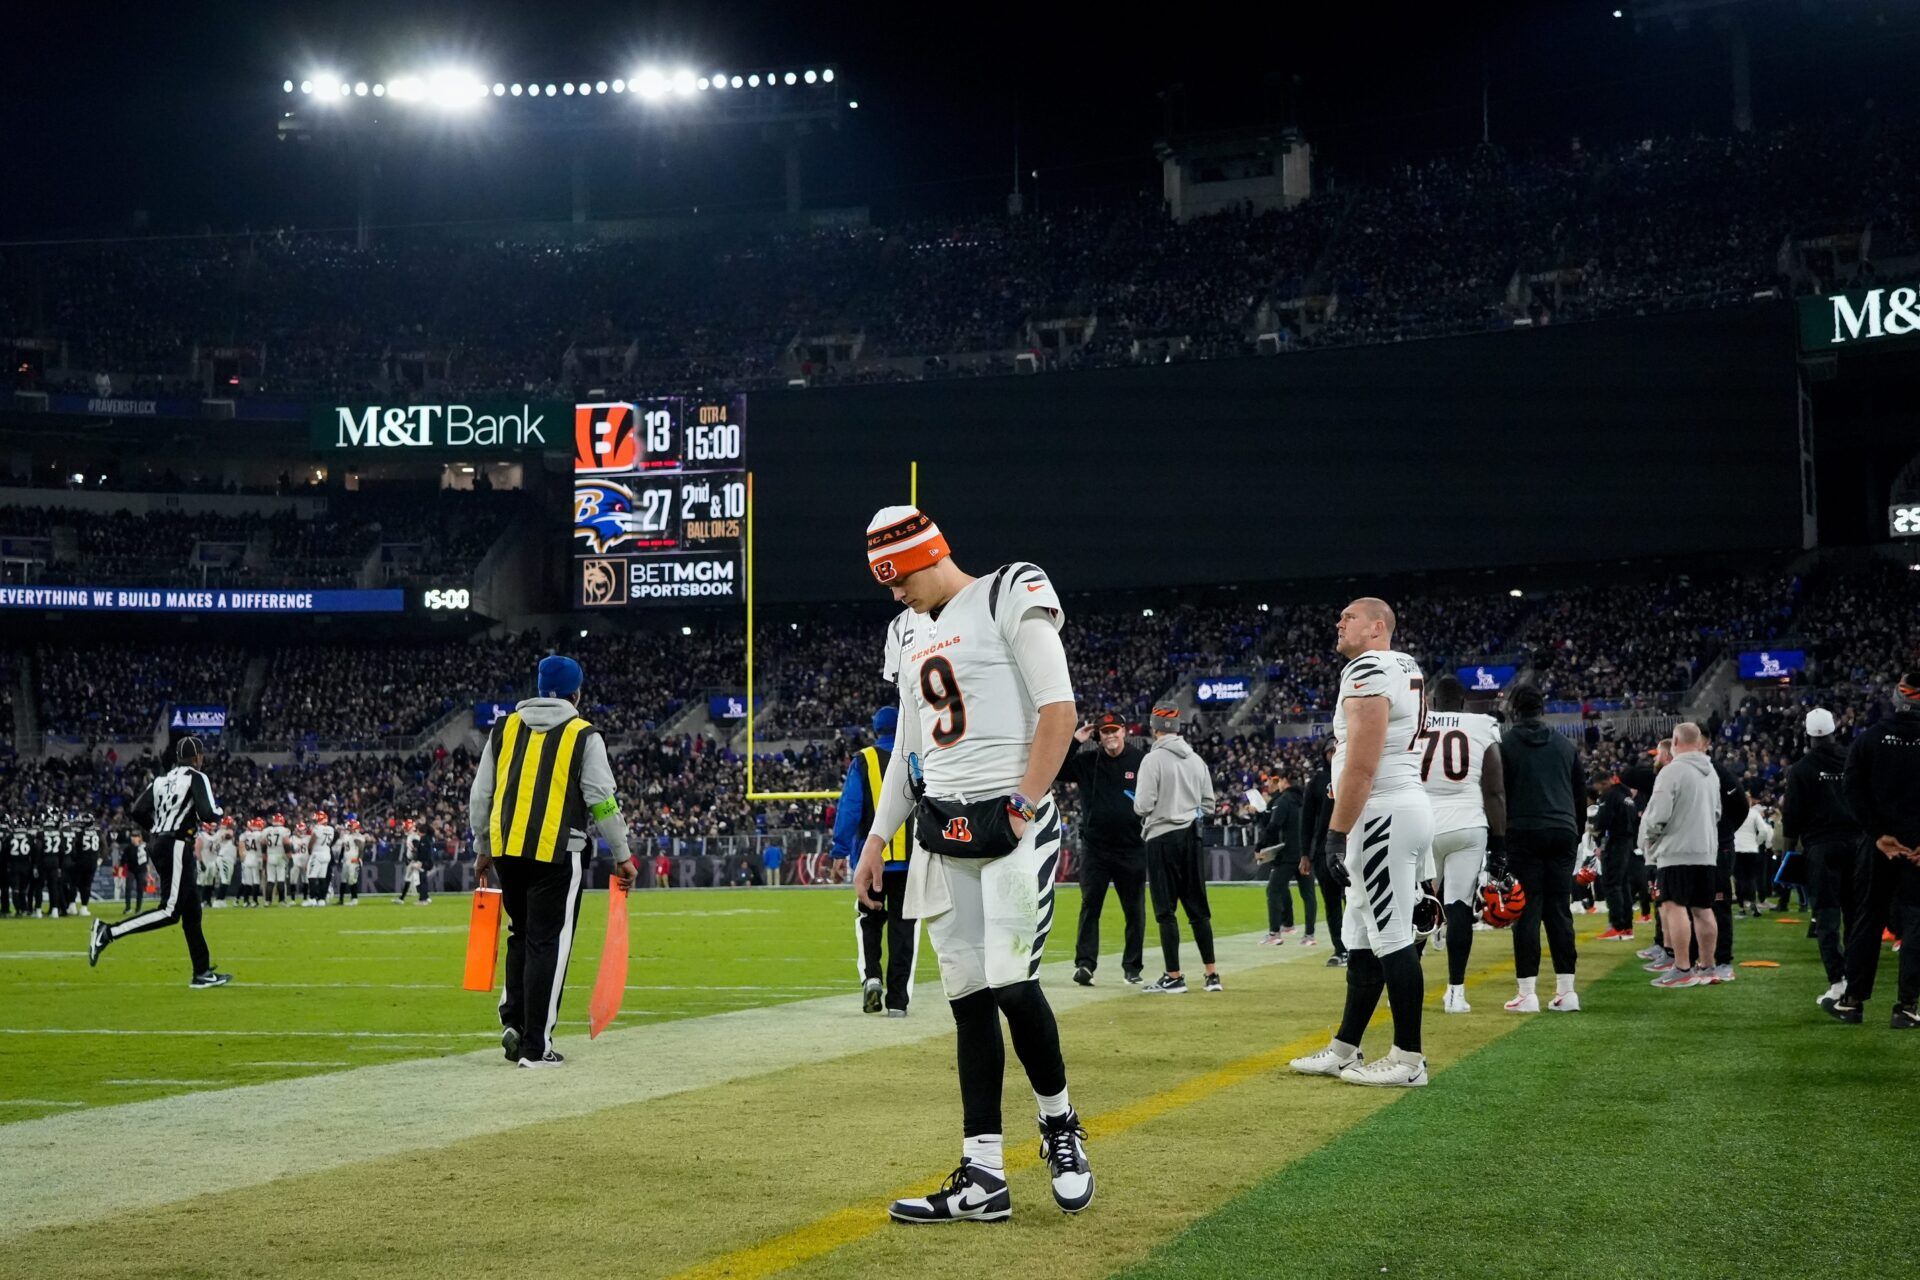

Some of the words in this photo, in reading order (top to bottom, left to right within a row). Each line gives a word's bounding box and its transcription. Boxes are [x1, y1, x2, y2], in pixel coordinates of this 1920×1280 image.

[1828, 287, 1920, 342] M&
[335, 405, 442, 447] M&T
[447, 403, 545, 445] Bank
[699, 407, 719, 424] QTR
[719, 405, 727, 422] 4
[644, 410, 671, 452] 13
[685, 425, 740, 460] 15:00
[642, 489, 672, 531] 27
[681, 483, 710, 520] 2nd
[710, 494, 722, 518] &
[722, 482, 745, 518] 10
[687, 522, 710, 539] BALL
[710, 521, 726, 538] ON
[726, 520, 740, 537] 25
[630, 561, 734, 584] BETMGM
[0, 588, 88, 606] EVERYTHING
[93, 591, 113, 606] WE
[118, 592, 161, 607] BUILD
[166, 592, 213, 608] MAKES
[217, 593, 227, 608] A
[231, 593, 313, 609] DIFFERENCE
[424, 589, 470, 610] 15:00
[630, 582, 734, 598] SPORTSBOOK
[920, 654, 966, 749] 9
[1426, 716, 1459, 728] SMITH
[1418, 729, 1470, 782] 70
[10, 838, 31, 856] 26
[44, 836, 61, 853] 32
[82, 834, 100, 852] 58
